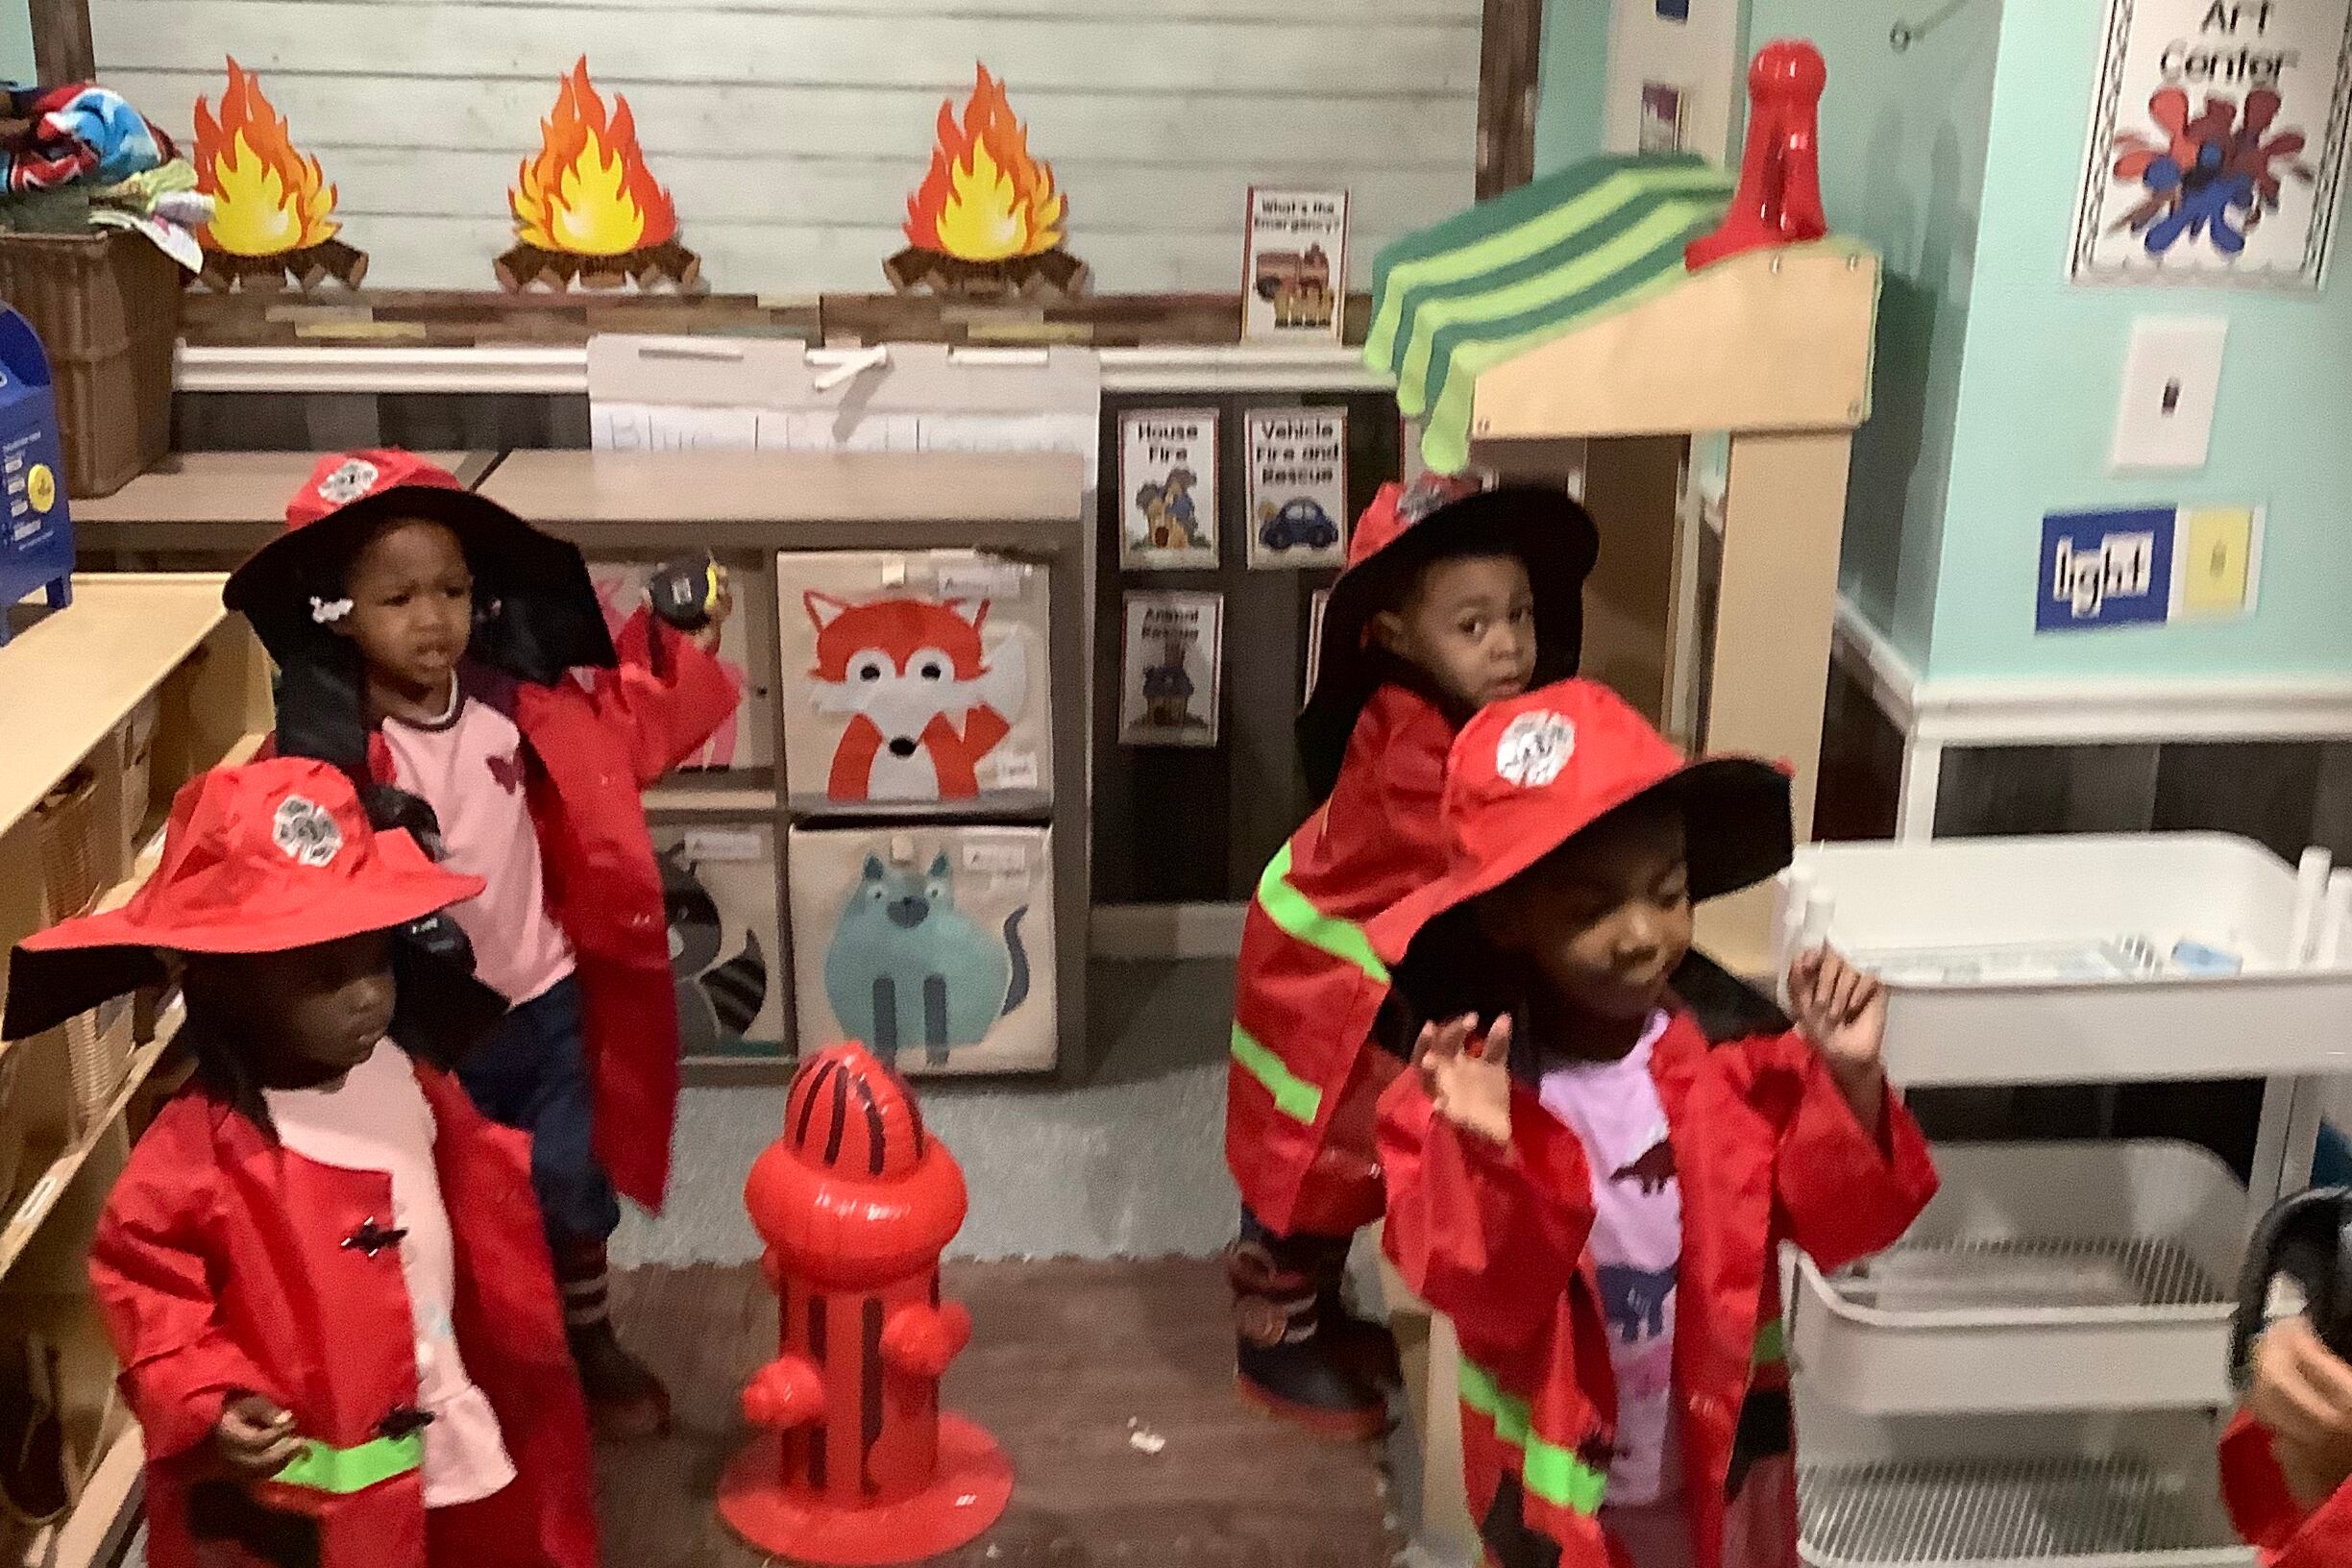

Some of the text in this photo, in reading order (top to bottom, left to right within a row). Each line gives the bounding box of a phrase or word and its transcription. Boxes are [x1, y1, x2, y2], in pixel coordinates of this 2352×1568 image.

[1139, 420, 1198, 442] House
[1262, 419, 1335, 441] Vehicle
[1148, 445, 1188, 464] Fire
[1256, 443, 1339, 464] Fire and
[1262, 467, 1335, 486] Rescue
[2056, 536, 2149, 616] light
